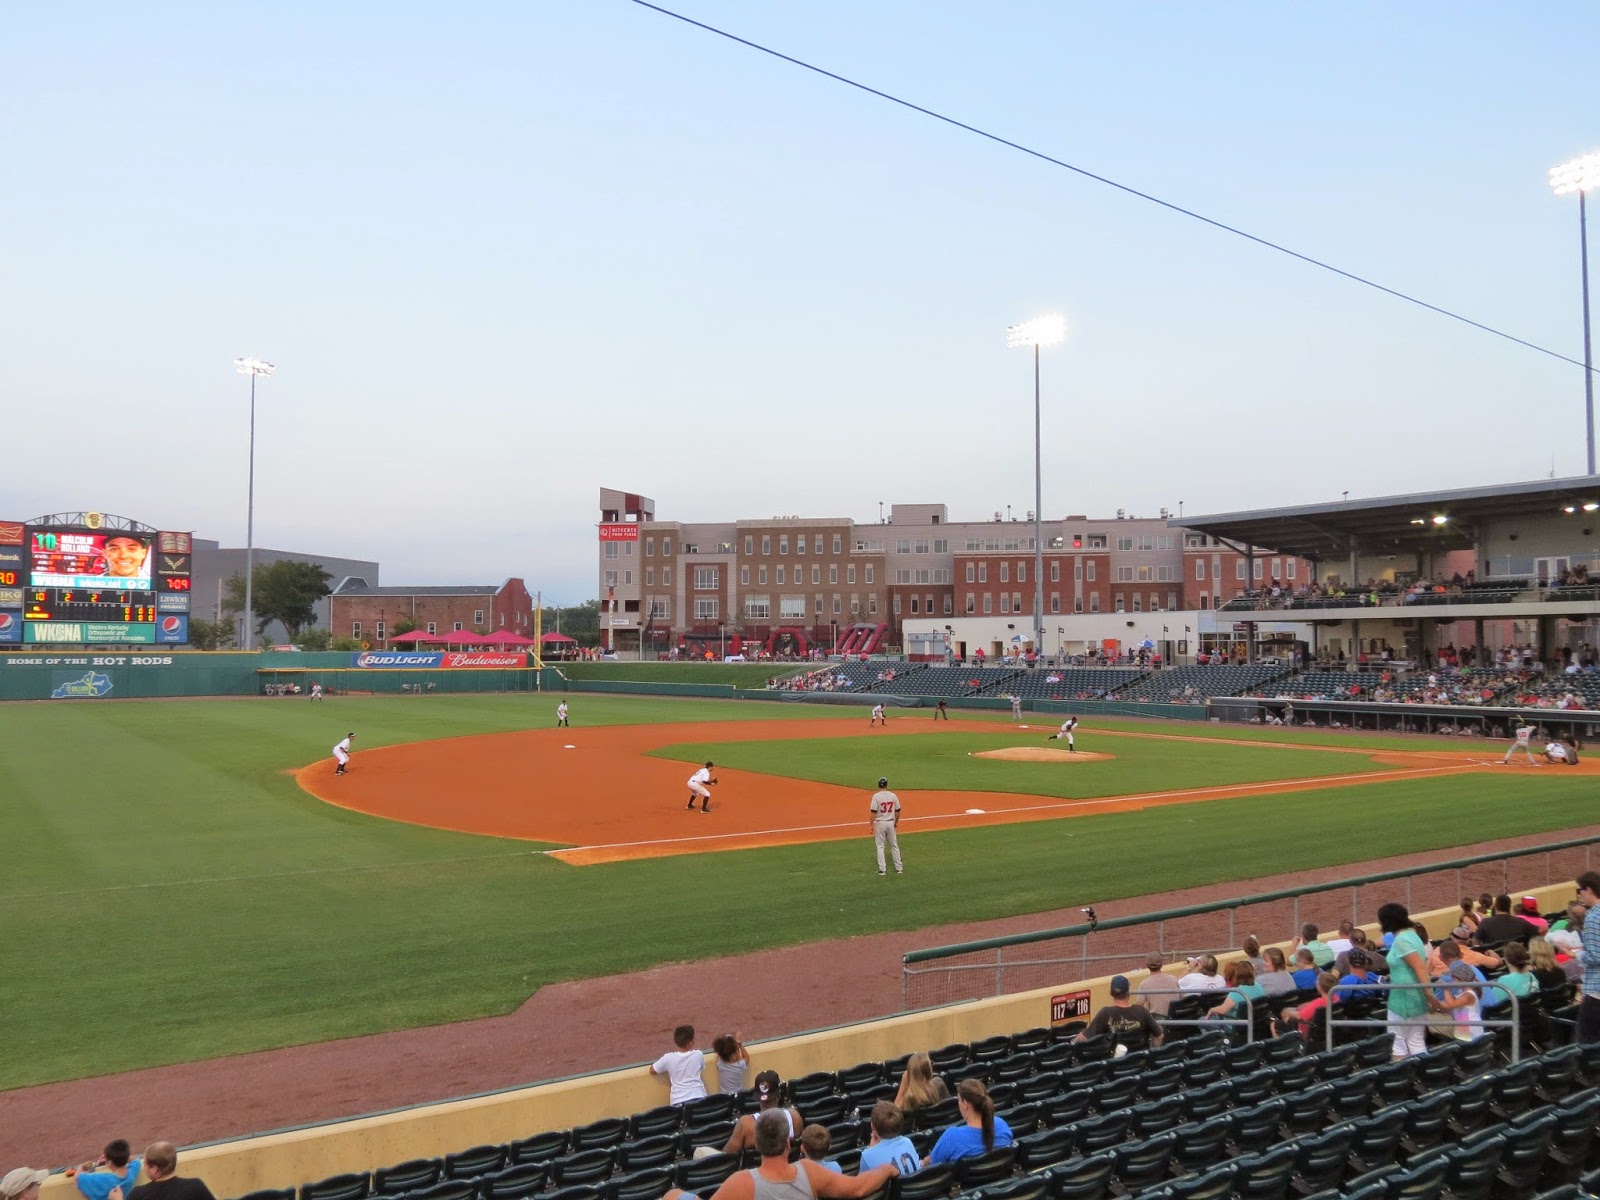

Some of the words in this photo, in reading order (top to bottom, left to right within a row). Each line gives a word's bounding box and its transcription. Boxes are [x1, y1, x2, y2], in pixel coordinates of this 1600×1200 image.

[36, 532, 57, 550] 10
[166, 578, 188, 590] 7:09
[36, 592, 46, 601] 10
[93, 657, 126, 666] HOT
[132, 656, 172, 666] RODS
[364, 656, 394, 664] BUD
[394, 656, 436, 664] LIGHT
[449, 654, 518, 666] Budweiser
[880, 801, 894, 813] 37
[1053, 1002, 1066, 1020] 117
[1076, 998, 1089, 1015] 116
